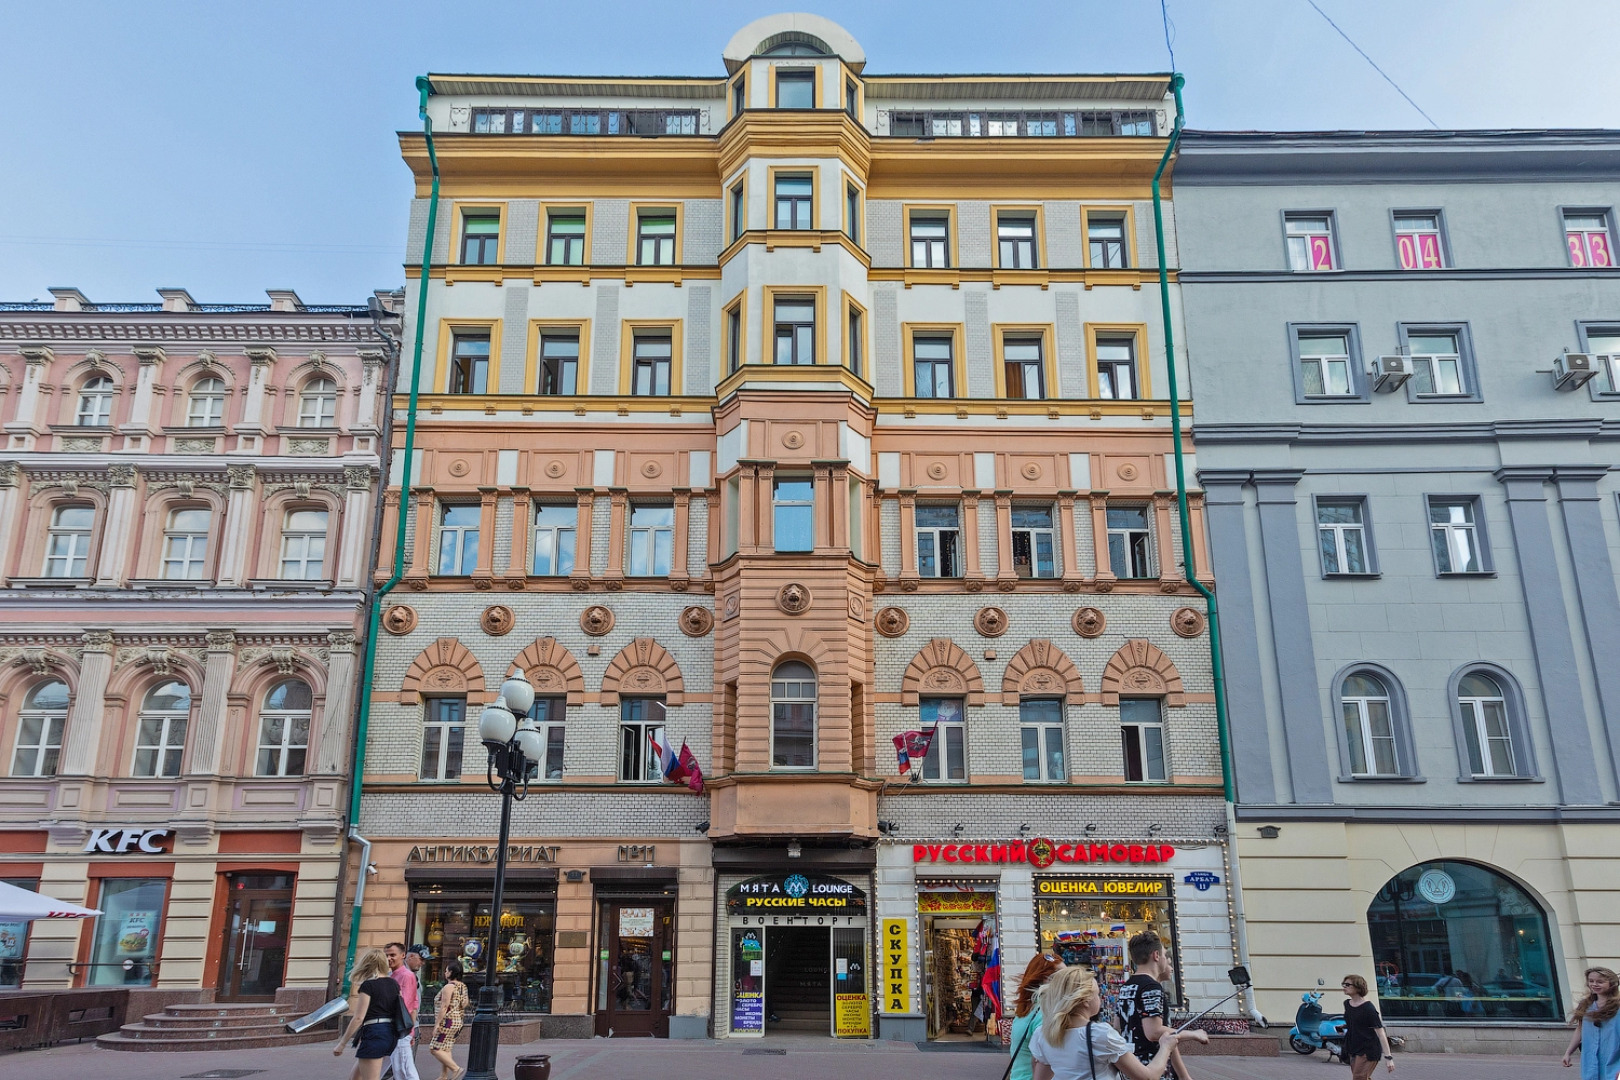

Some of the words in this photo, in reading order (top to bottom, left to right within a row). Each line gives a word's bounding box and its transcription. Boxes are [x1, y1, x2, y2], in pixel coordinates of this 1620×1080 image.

[82, 829, 168, 853] KFC
[913, 839, 1026, 863] РУССКИЙ
[1057, 843, 1175, 863] САМОВАР
[740, 884, 781, 893] МЯТА
[812, 885, 853, 894] LOUNGE
[1039, 881, 1098, 895] ОЦЕНКА
[1103, 881, 1163, 894] ЮВЕЛИР
[746, 898, 806, 907] РУССКИЕ
[808, 898, 847, 907] ЧАСЫ
[742, 916, 853, 925] ВОЕНТОРГ
[889, 924, 904, 1010] СКУПКА
